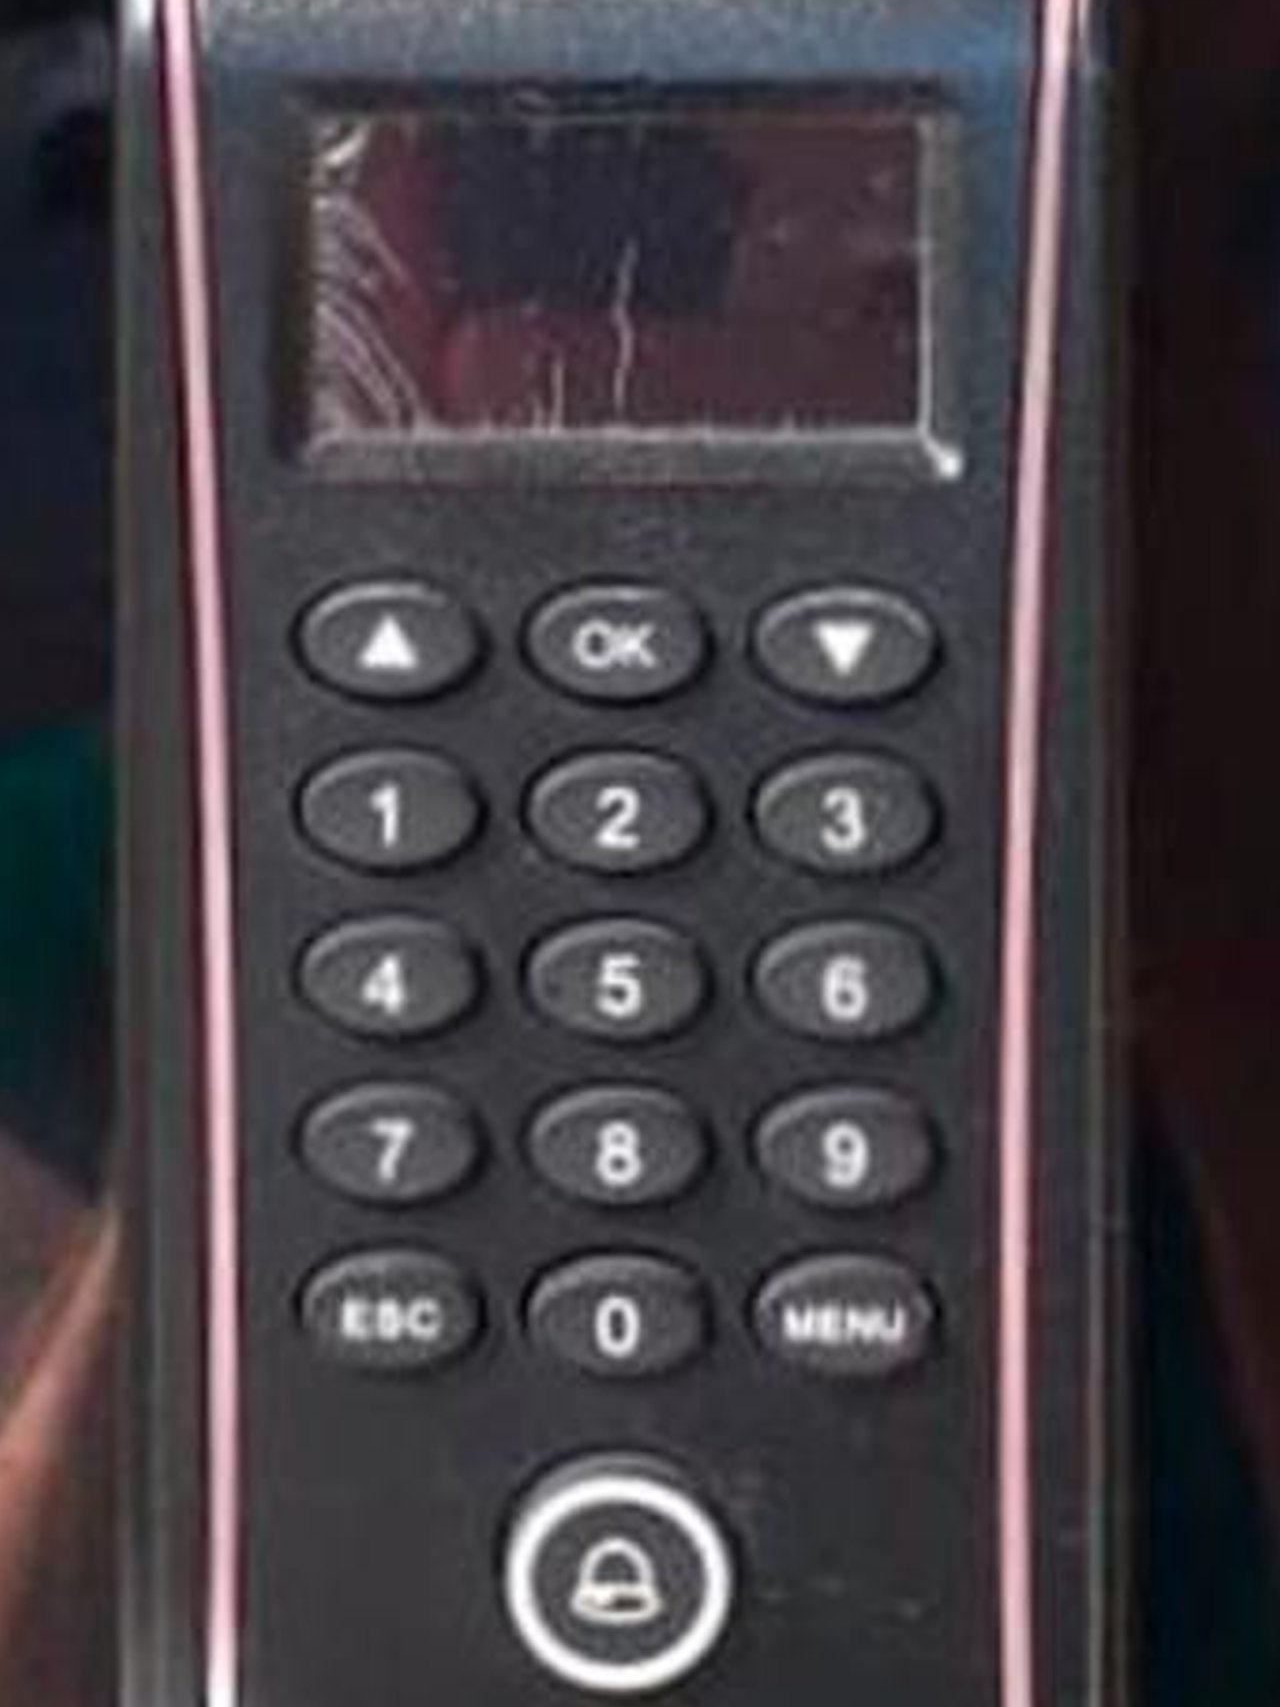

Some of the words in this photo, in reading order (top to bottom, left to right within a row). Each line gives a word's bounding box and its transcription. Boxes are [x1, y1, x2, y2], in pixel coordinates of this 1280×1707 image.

[571, 618, 657, 671] OK
[370, 784, 400, 848] 1
[595, 785, 641, 851] 2
[821, 786, 868, 854] 3
[361, 954, 407, 1015] 4
[596, 953, 643, 1019] 5
[821, 955, 870, 1022] 6
[370, 1117, 415, 1183] 7
[594, 1120, 643, 1187] 8
[821, 1121, 870, 1189] 9
[339, 1296, 441, 1342] ESC
[594, 1294, 642, 1359] 0
[782, 1303, 906, 1345] MENU
